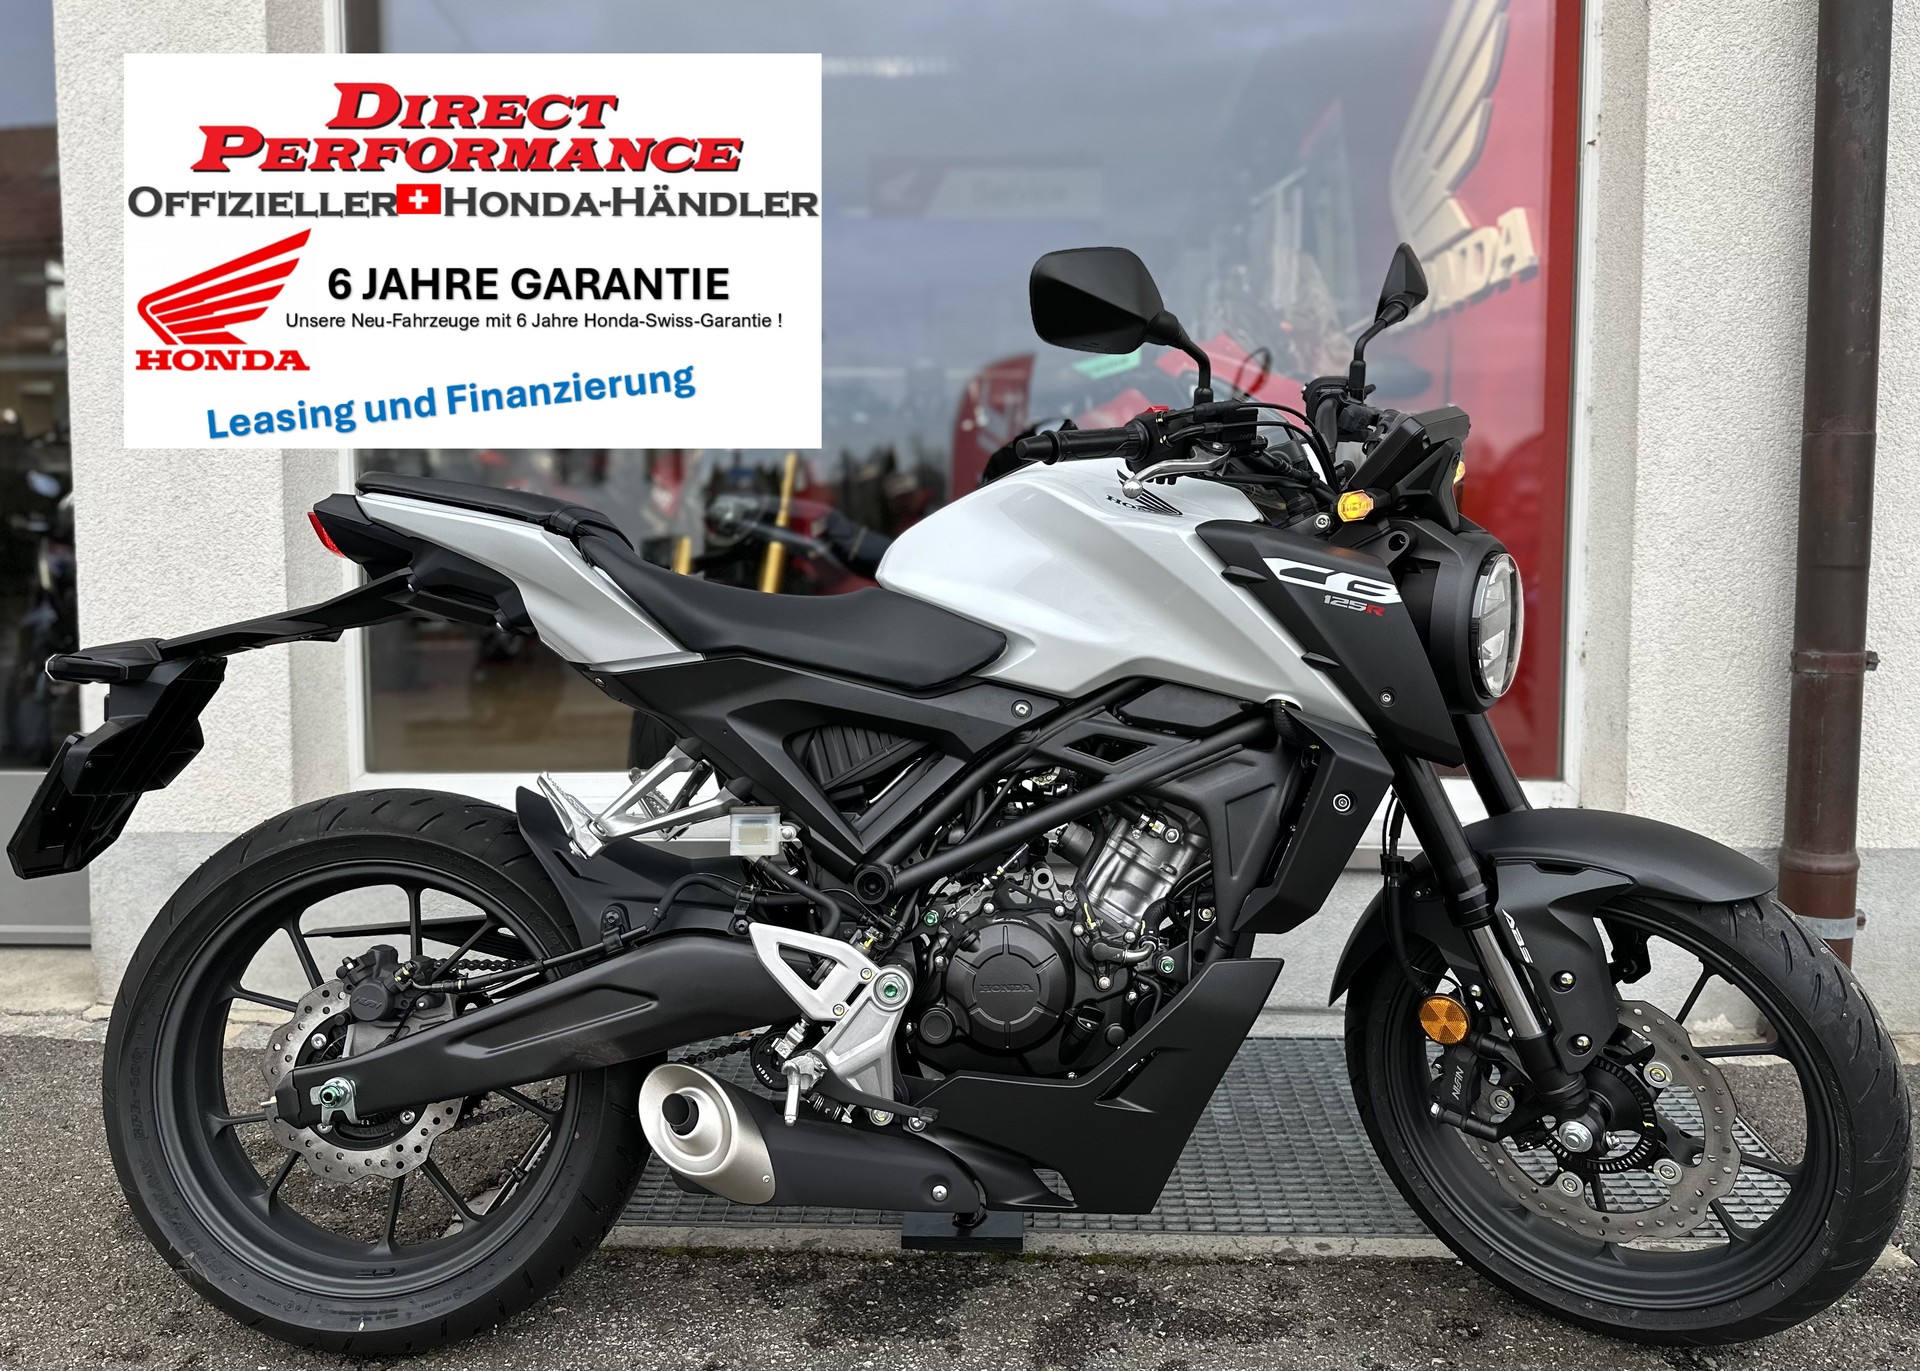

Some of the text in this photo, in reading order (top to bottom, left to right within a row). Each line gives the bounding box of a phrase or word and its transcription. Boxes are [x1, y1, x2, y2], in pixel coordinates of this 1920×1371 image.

[1262, 557, 1402, 604] CB
[1323, 594, 1387, 617] 125R
[979, 984, 1034, 993] HONDA
